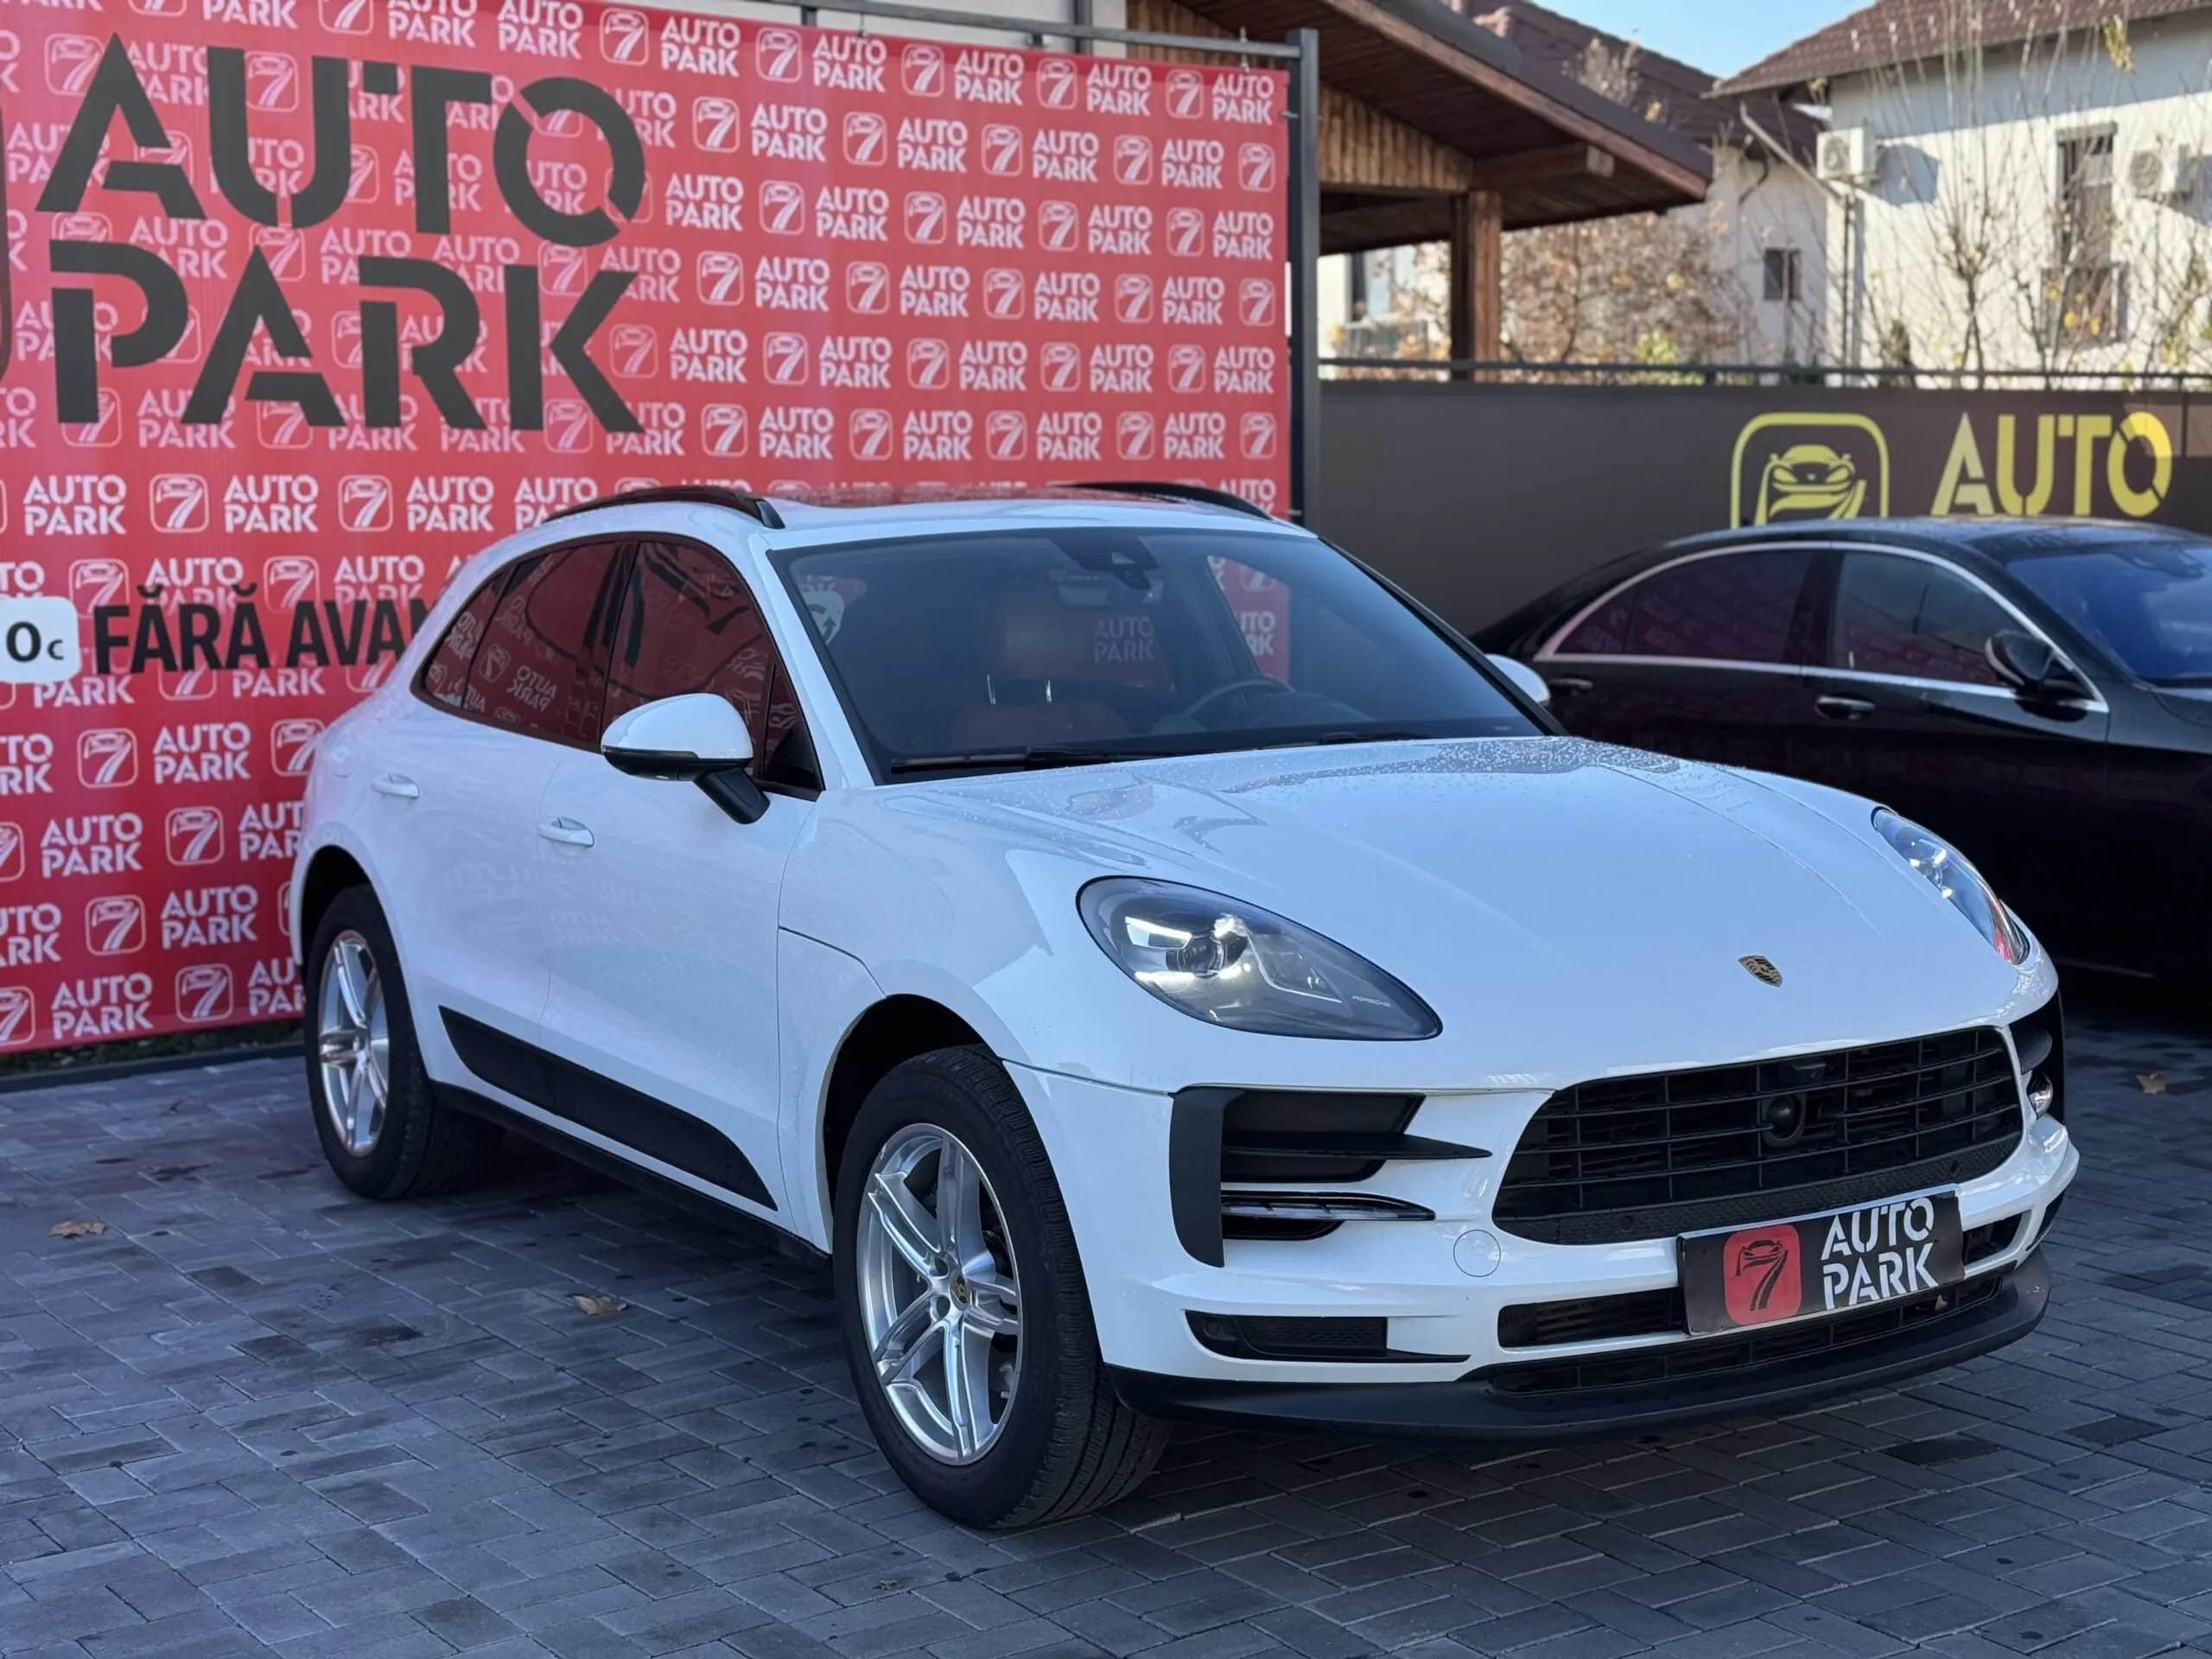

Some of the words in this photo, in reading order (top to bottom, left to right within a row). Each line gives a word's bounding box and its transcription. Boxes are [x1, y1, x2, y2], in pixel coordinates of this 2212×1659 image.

[498, 1, 584, 30] AUTO
[389, 13, 477, 48] PARK
[498, 23, 582, 60] PARK
[660, 16, 741, 49] AUTO
[660, 42, 740, 78] PARK
[812, 34, 887, 66] AUTO
[813, 60, 886, 92] PARK
[953, 50, 1025, 81] AUTO
[1086, 63, 1153, 92] AUTO
[954, 74, 1023, 105] PARK
[1211, 73, 1274, 101] AUTO
[615, 89, 677, 120] UTO
[1086, 87, 1151, 117] PARK
[1212, 98, 1274, 124] PARK
[750, 104, 828, 134] AUTO
[896, 118, 967, 146] AUTO
[35, 31, 646, 248] AUTO
[751, 130, 827, 162] PARK
[1032, 130, 1099, 157] AUTO
[1160, 139, 1224, 166] AUTO
[896, 143, 967, 173] PARK
[1032, 154, 1098, 183] PARK
[664, 173, 745, 204] AUTO
[1160, 162, 1223, 190] PARK
[815, 186, 890, 215] AUTO
[956, 195, 1027, 224] AUTO
[665, 199, 744, 232] PARK
[815, 213, 889, 242] PARK
[1087, 204, 1154, 231] AUTO
[1212, 211, 1274, 237] AUTO
[129, 216, 229, 248] AUTO
[320, 228, 411, 259] AUTO
[956, 219, 1025, 250] PARK
[1087, 228, 1153, 256] PARK
[432, 235, 521, 264] AUTO
[600, 247, 682, 276] AUTO
[1212, 233, 1274, 262] PARK
[754, 256, 830, 284] AUTO
[899, 265, 970, 292] AUTO
[1034, 271, 1101, 298] AUTO
[754, 283, 830, 313] PARK
[1161, 276, 1225, 302] AUTO
[899, 290, 969, 318] PARK
[1034, 296, 1100, 323] PARK
[1161, 298, 1224, 325] PARK
[49, 239, 646, 434] PARK
[670, 327, 749, 355] AUTO
[818, 336, 893, 364] AUTO
[670, 353, 747, 383] PARK
[959, 340, 1028, 367] AUTO
[1089, 343, 1154, 369] AUTO
[1214, 346, 1275, 371] AUTO
[819, 362, 892, 390] PARK
[959, 364, 1027, 392] PARK
[1089, 367, 1154, 394] PARK
[1214, 368, 1274, 395] PARK
[138, 417, 236, 448] PARK
[759, 406, 835, 434] AUTO
[902, 410, 973, 436] AUTO
[1036, 411, 1103, 437] AUTO
[1163, 411, 1227, 436] AUTO
[606, 430, 685, 456] PARK
[760, 432, 834, 461] PARK
[903, 434, 973, 462] PARK
[1036, 435, 1102, 461] PARK
[1163, 435, 1225, 461] PARK
[1930, 410, 2172, 517] AUTO
[22, 474, 127, 505] AUTO
[223, 474, 320, 504] AUTO
[406, 476, 495, 504] AUTO
[514, 476, 599, 504] AUTO
[24, 505, 127, 537] PARK
[224, 504, 319, 533] PARK
[407, 504, 494, 533] PARK
[144, 557, 245, 587] AUTO
[333, 555, 424, 584] AUTO
[93, 582, 271, 675] FĂRĂ
[34, 673, 135, 709] PARK
[232, 668, 325, 699] PARK
[153, 721, 252, 754] AUTO
[154, 751, 251, 785] PARK
[40, 811, 143, 849] AUTO
[41, 842, 143, 879] PARK
[160, 884, 259, 920] AUTO
[161, 912, 257, 950] PARK
[50, 972, 154, 1012] AUTO
[52, 1001, 154, 1040] PARK
[1820, 1197, 1935, 1261] AUTO
[1822, 1242, 1939, 1311] PARK
